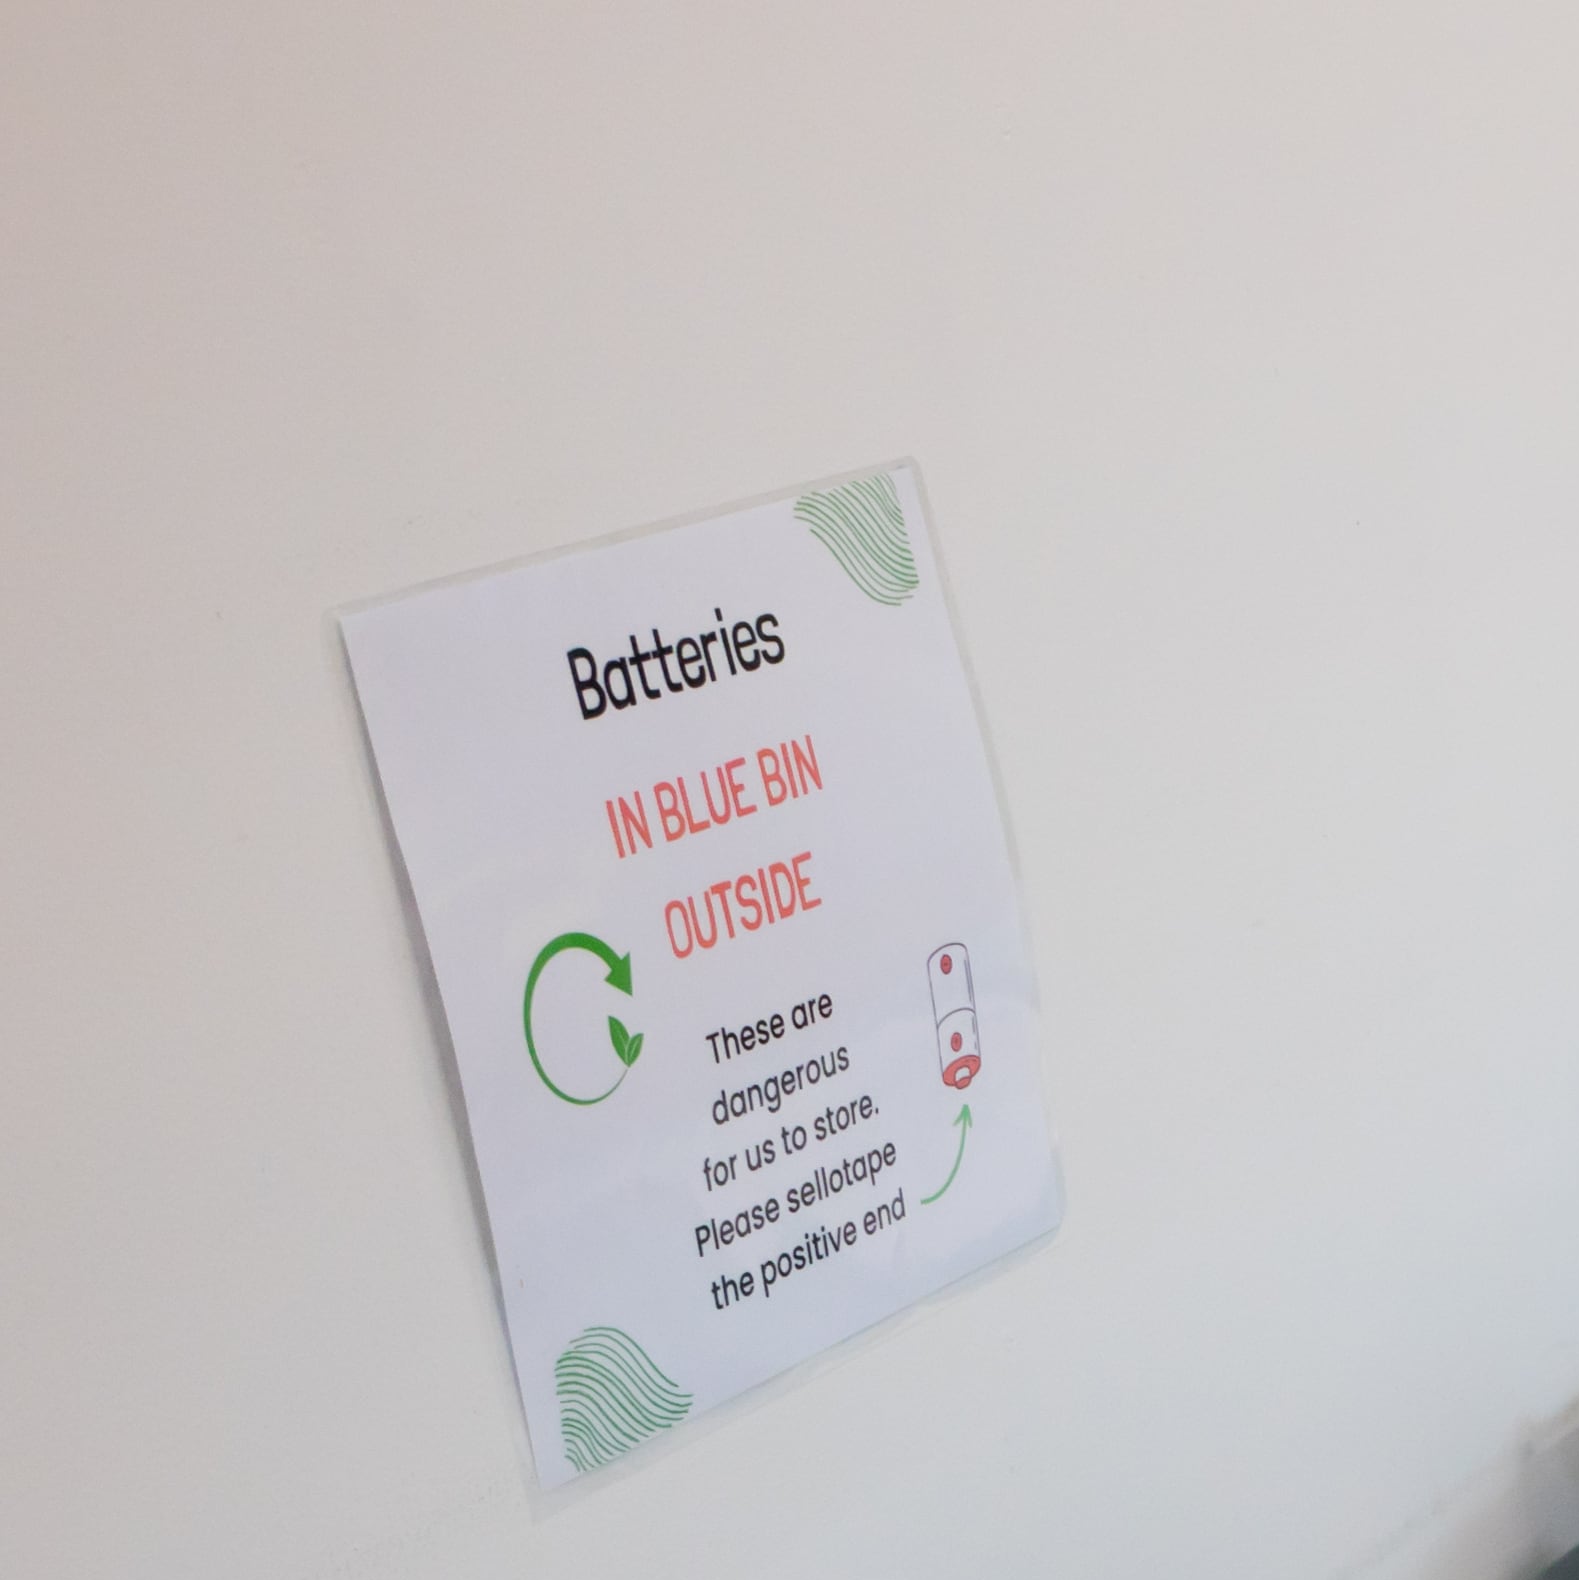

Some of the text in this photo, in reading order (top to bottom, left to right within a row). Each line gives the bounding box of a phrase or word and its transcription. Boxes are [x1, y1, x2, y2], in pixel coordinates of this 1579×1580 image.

[566, 608, 785, 720] Batteries
[606, 735, 823, 859] IN BLUE BIN
[664, 851, 822, 960] OUTSIDE
[706, 994, 833, 1064] These are
[712, 1047, 850, 1125] dangerous
[703, 1094, 880, 1192] for us to store.
[695, 1142, 897, 1258] Please sellotape
[711, 1187, 907, 1310] the positive end
